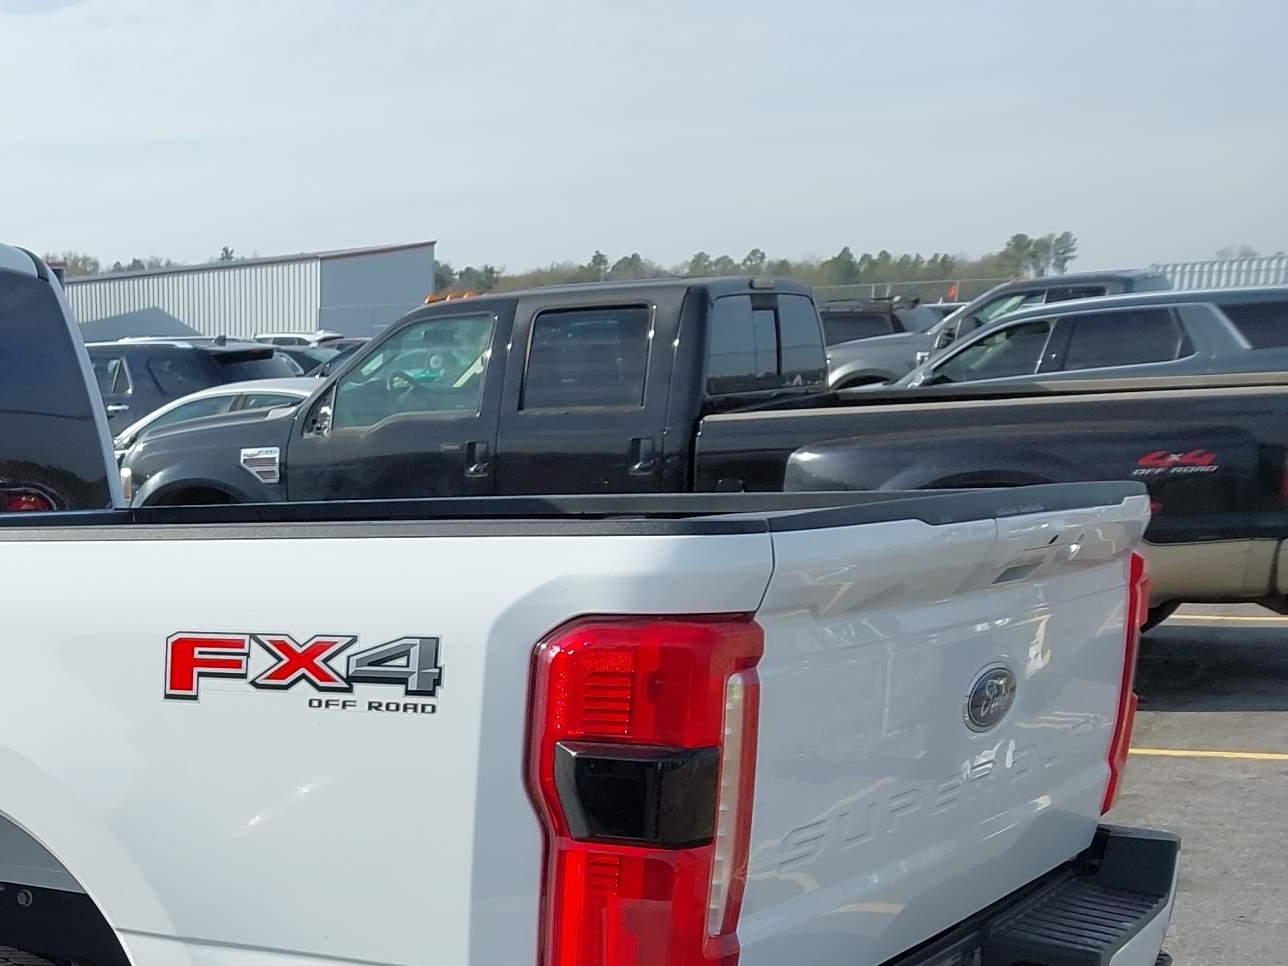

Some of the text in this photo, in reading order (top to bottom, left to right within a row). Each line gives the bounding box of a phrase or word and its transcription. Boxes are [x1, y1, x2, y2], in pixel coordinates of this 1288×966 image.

[1133, 465, 1218, 475] OFF ROAD
[164, 631, 443, 698] FX4
[308, 698, 436, 714] OFF ROAD
